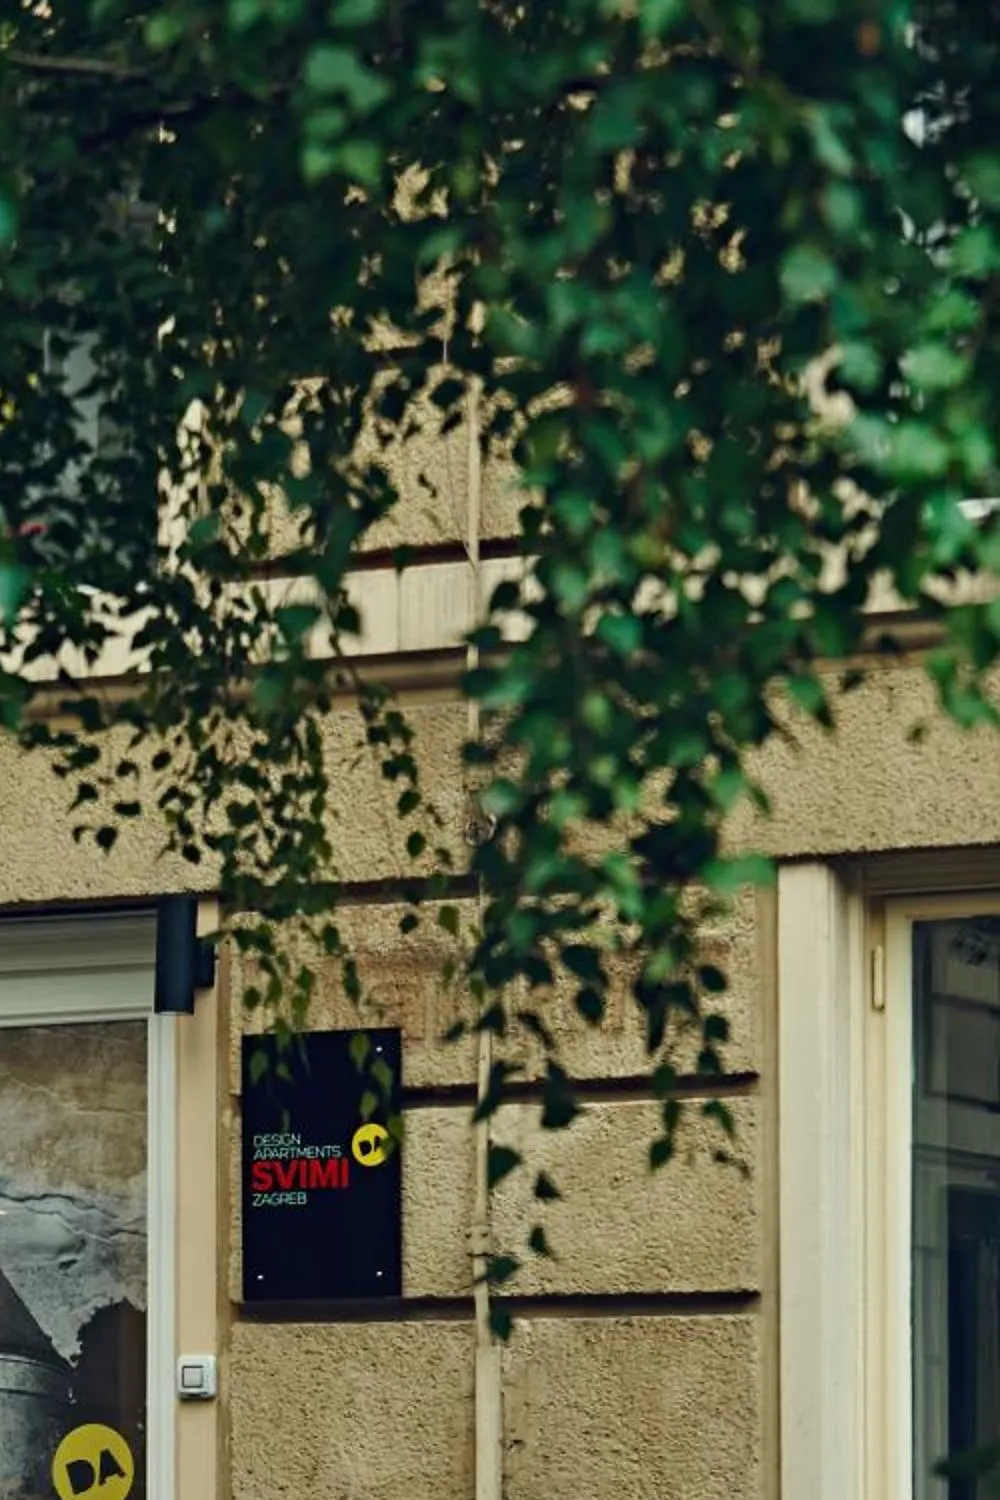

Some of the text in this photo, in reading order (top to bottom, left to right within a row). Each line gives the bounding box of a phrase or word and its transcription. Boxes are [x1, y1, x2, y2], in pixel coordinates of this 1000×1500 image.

[252, 1133, 302, 1147] DESIGN
[252, 1145, 342, 1160] APARTMENTS
[251, 1157, 349, 1192] SVIMI
[251, 1191, 308, 1207] ZAGREB
